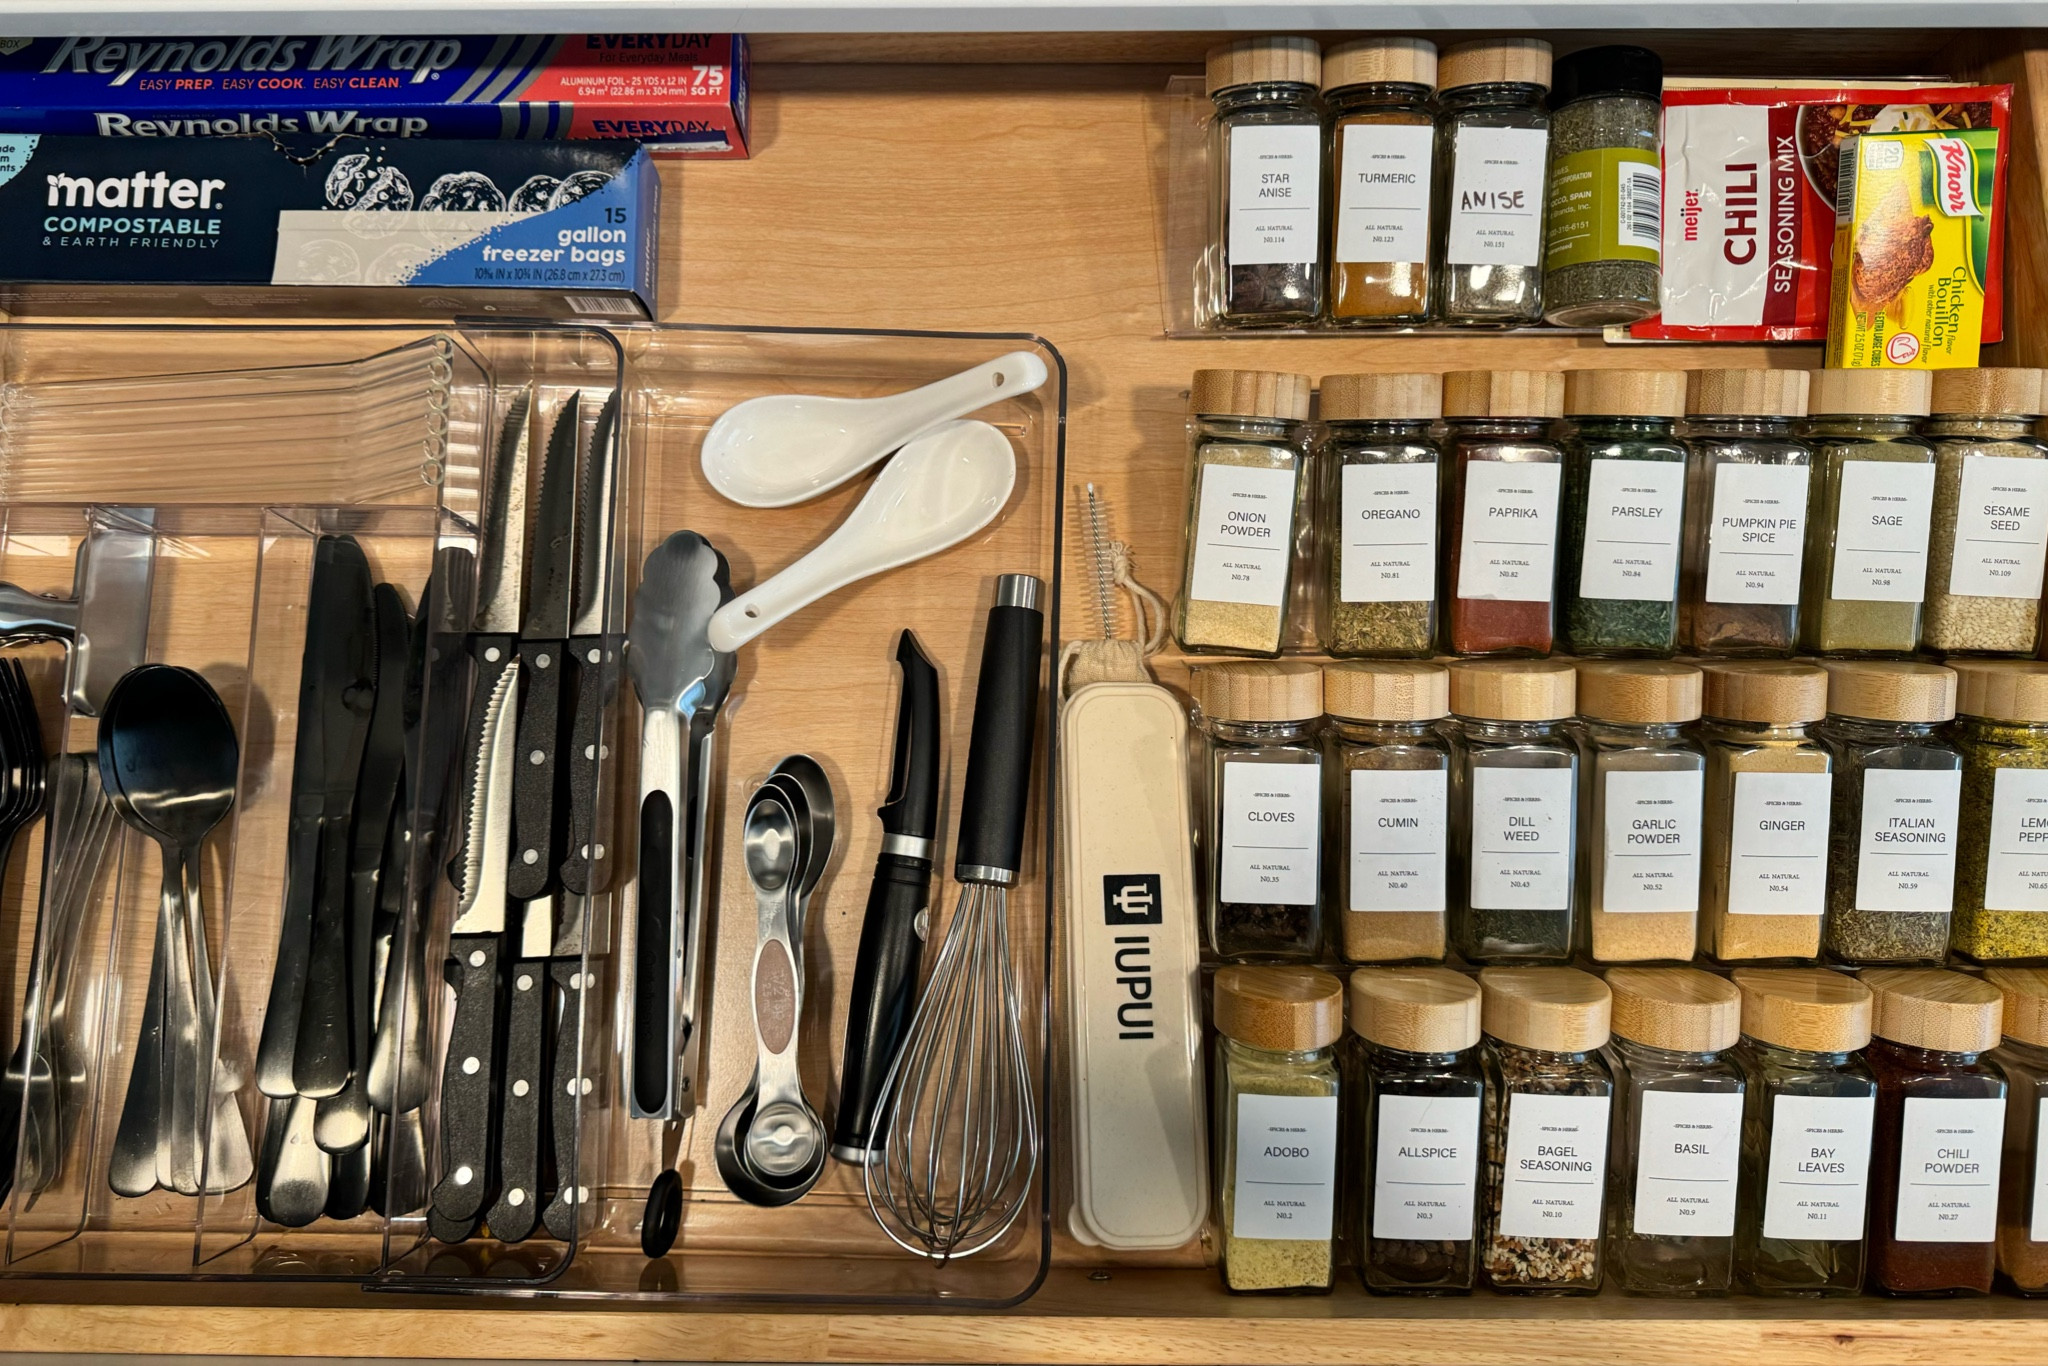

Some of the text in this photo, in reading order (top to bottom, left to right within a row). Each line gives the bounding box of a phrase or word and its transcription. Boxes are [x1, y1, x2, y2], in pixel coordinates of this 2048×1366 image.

[587, 34, 712, 48] EVERYDAY
[40, 36, 461, 86] Reynolds Wrap
[601, 52, 698, 64] For Everyday Meals
[560, 77, 606, 86] ALUMINUM
[608, 77, 625, 86] FOIL
[632, 76, 642, 85] 25
[644, 76, 658, 85] YDS
[668, 76, 676, 85] 12
[678, 76, 686, 84] IN
[692, 66, 724, 86] 75
[139, 76, 401, 91] EASY PREP. EASY COOK. EASY CLEAN.
[578, 86, 596, 96] 6.94
[652, 86, 667, 95] 304
[690, 86, 722, 96] SQ FT
[94, 110, 428, 138] Reynolds Wrap
[592, 120, 710, 133] EVERYDAY
[1262, 173, 1290, 184] STAR
[1358, 173, 1416, 184] TURMERIC
[1940, 140, 1966, 213] Knorr
[47, 171, 226, 209] matter
[1258, 187, 1291, 198] ANISE
[1570, 190, 1592, 200] SPAIN
[1461, 190, 1524, 211] ANISE
[605, 208, 626, 224] 15
[1681, 189, 1702, 242] meijer
[1724, 162, 1758, 266] CHILI
[1774, 135, 1795, 294] SEASONING MIX
[44, 216, 222, 235] COMPOSTABLE
[42, 236, 220, 248] & EARTH FRIENDLY
[558, 226, 626, 247] gallon
[482, 245, 626, 266] freezer bags
[495, 268, 506, 280] IN
[507, 270, 512, 279] x
[532, 268, 542, 280] IN
[568, 272, 580, 280] cm
[582, 272, 587, 280] x
[1932, 277, 1952, 347] Bouillon
[1944, 266, 1967, 354] Chicken flavor
[1856, 312, 1866, 324] NET
[1874, 316, 1885, 332] EXTRA
[1920, 284, 1936, 364] with other natural flavor
[1856, 324, 1866, 332] WT
[1854, 342, 1864, 351] OZ
[1872, 332, 1884, 349] LARGE
[1870, 350, 1882, 367] CUBES
[1228, 511, 1266, 523] ONION
[1362, 509, 1420, 520] OREGANO
[1489, 507, 1538, 518] PAPRIKA
[1612, 506, 1663, 518] PARSLEY
[1984, 505, 2030, 517] SESAME
[1722, 517, 1796, 529] PUMPKIN PIE
[1872, 515, 1903, 526] SAGE
[1990, 520, 2020, 531] SEED
[1220, 525, 1270, 538] POWDER
[1742, 532, 1776, 543] SPICE
[1248, 812, 1295, 822] CLOVES
[1378, 818, 1418, 828] CUMIN
[1509, 816, 1536, 827] DILL
[1889, 818, 1935, 828] ITALIAN
[1632, 819, 1676, 830] GARLIC
[1760, 820, 1805, 830] GINGER
[1504, 831, 1540, 841] WEED
[1628, 834, 1680, 844] POWDER
[1874, 832, 1946, 842] SEASONING
[1114, 936, 1154, 1040] IUPUI
[1264, 1146, 1309, 1158] ADOBO
[1398, 1146, 1456, 1158] ALLSPICE
[1538, 1146, 1578, 1157] BAGEL
[1674, 1143, 1709, 1154] BASIL
[1811, 1148, 1836, 1158] BAY
[1937, 1148, 1969, 1159] CHILI
[1520, 1159, 1592, 1172] SEASONING
[1798, 1162, 1844, 1173] LEAVES
[1925, 1162, 1979, 1174] POWDER
